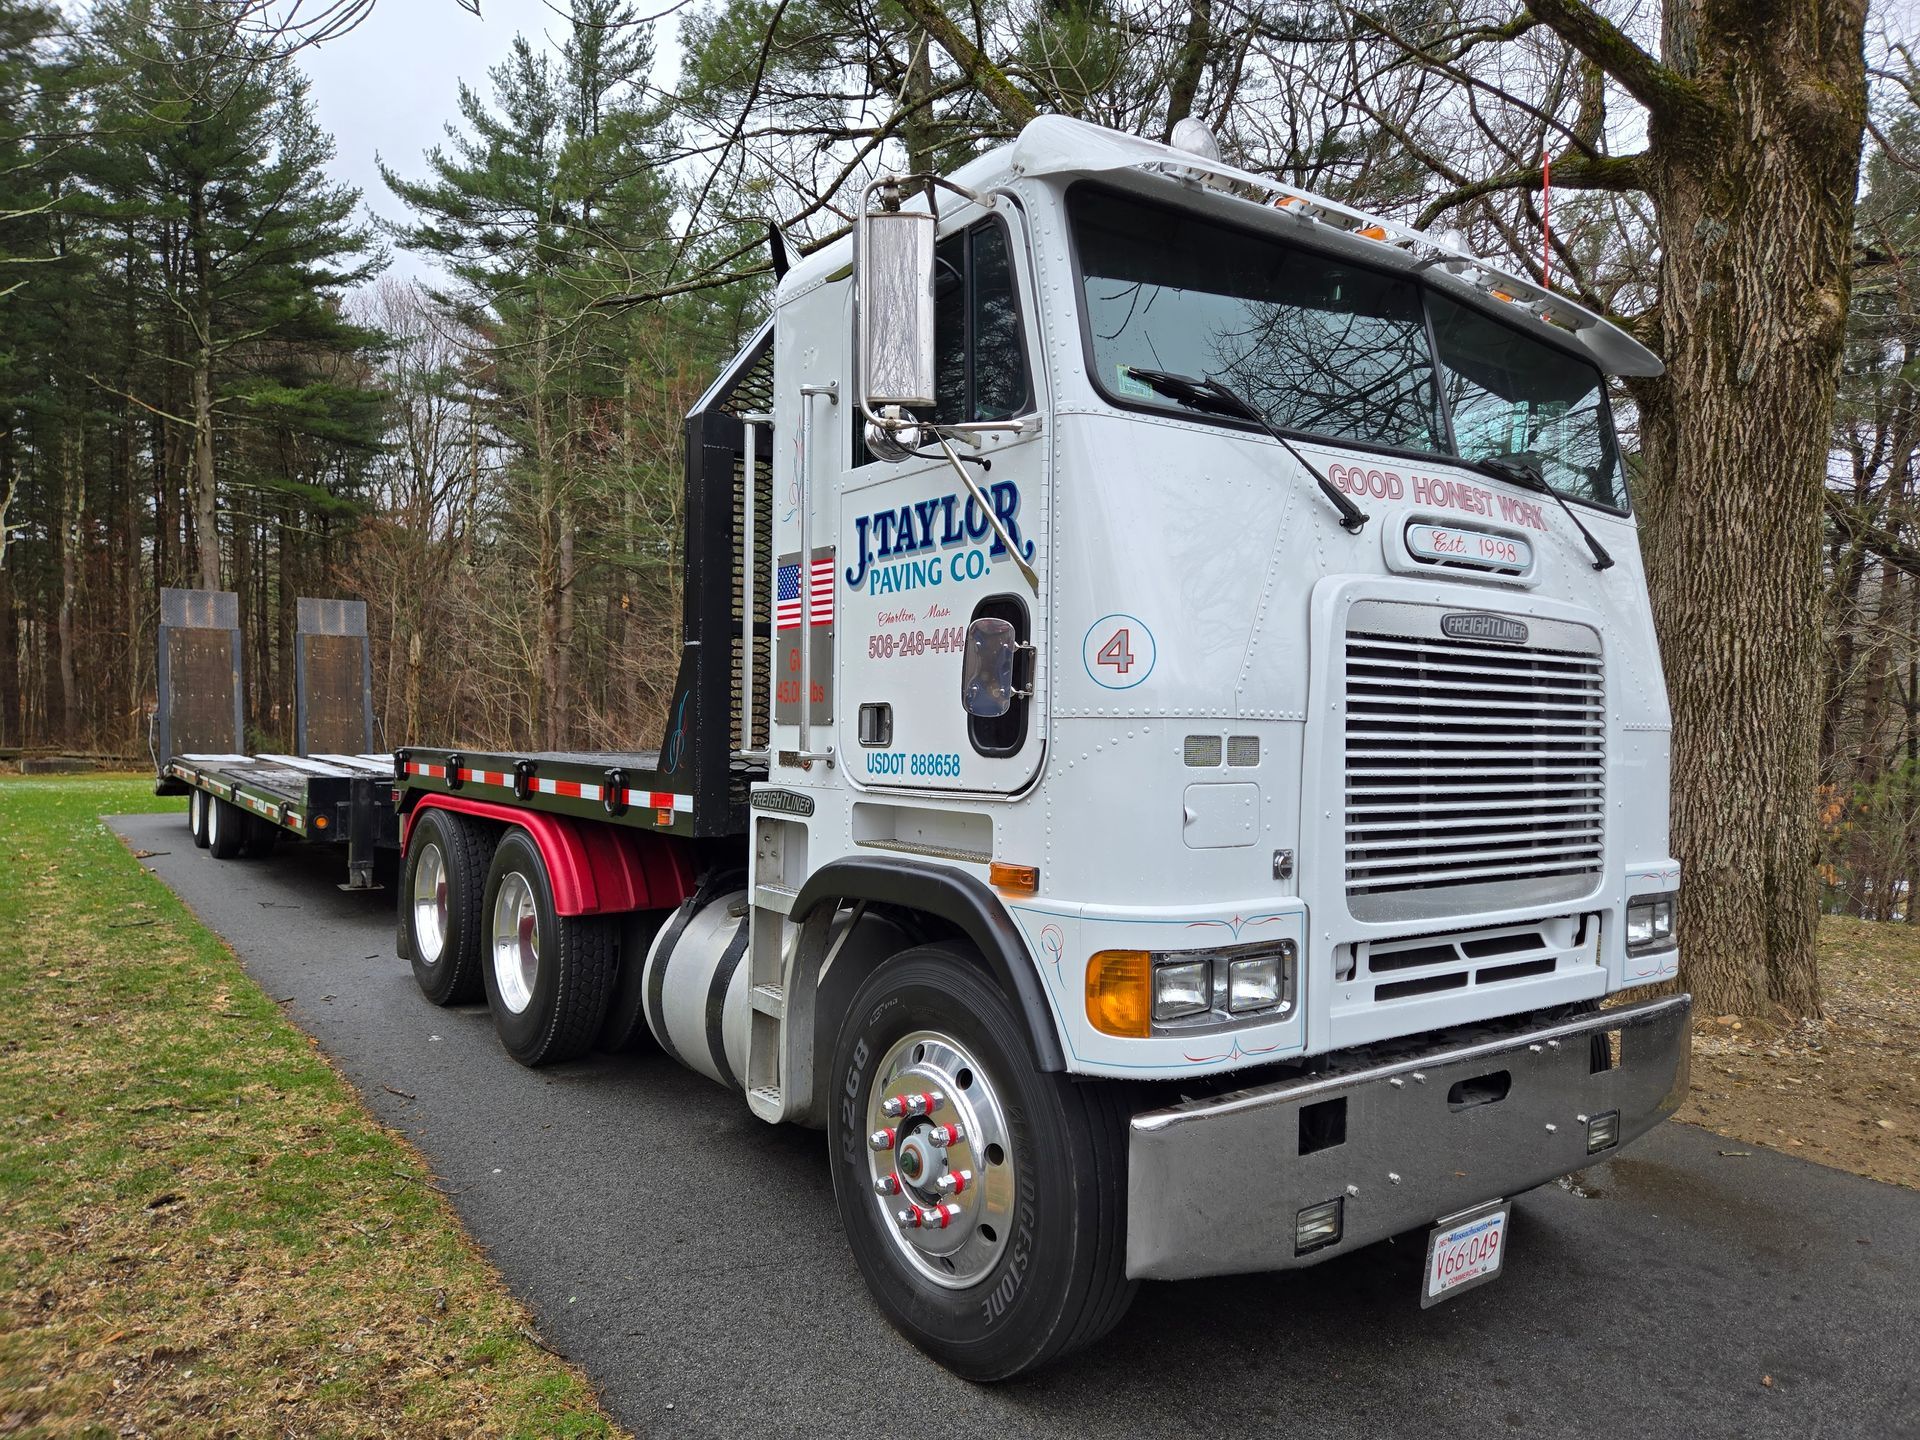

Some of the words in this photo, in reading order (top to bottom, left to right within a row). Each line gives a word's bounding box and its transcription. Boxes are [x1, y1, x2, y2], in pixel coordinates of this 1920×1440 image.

[1328, 463, 1404, 500] GOOD
[1411, 476, 1494, 517] HONEST
[1497, 494, 1549, 532] WORK
[1431, 531, 1468, 554] Est.
[1478, 538, 1518, 563] 1998
[870, 557, 942, 596] PAVING
[951, 550, 990, 581] CO.
[869, 627, 964, 659] 508-248-4414
[1448, 614, 1527, 640] FREIGHTLINER
[1097, 629, 1134, 673] 4
[867, 753, 906, 775] USDOT
[911, 753, 961, 777] 888658
[752, 791, 811, 813] FREIGHTLINER
[842, 1036, 870, 1165] R268
[1447, 1267, 1480, 1286] COMMERCIAL
